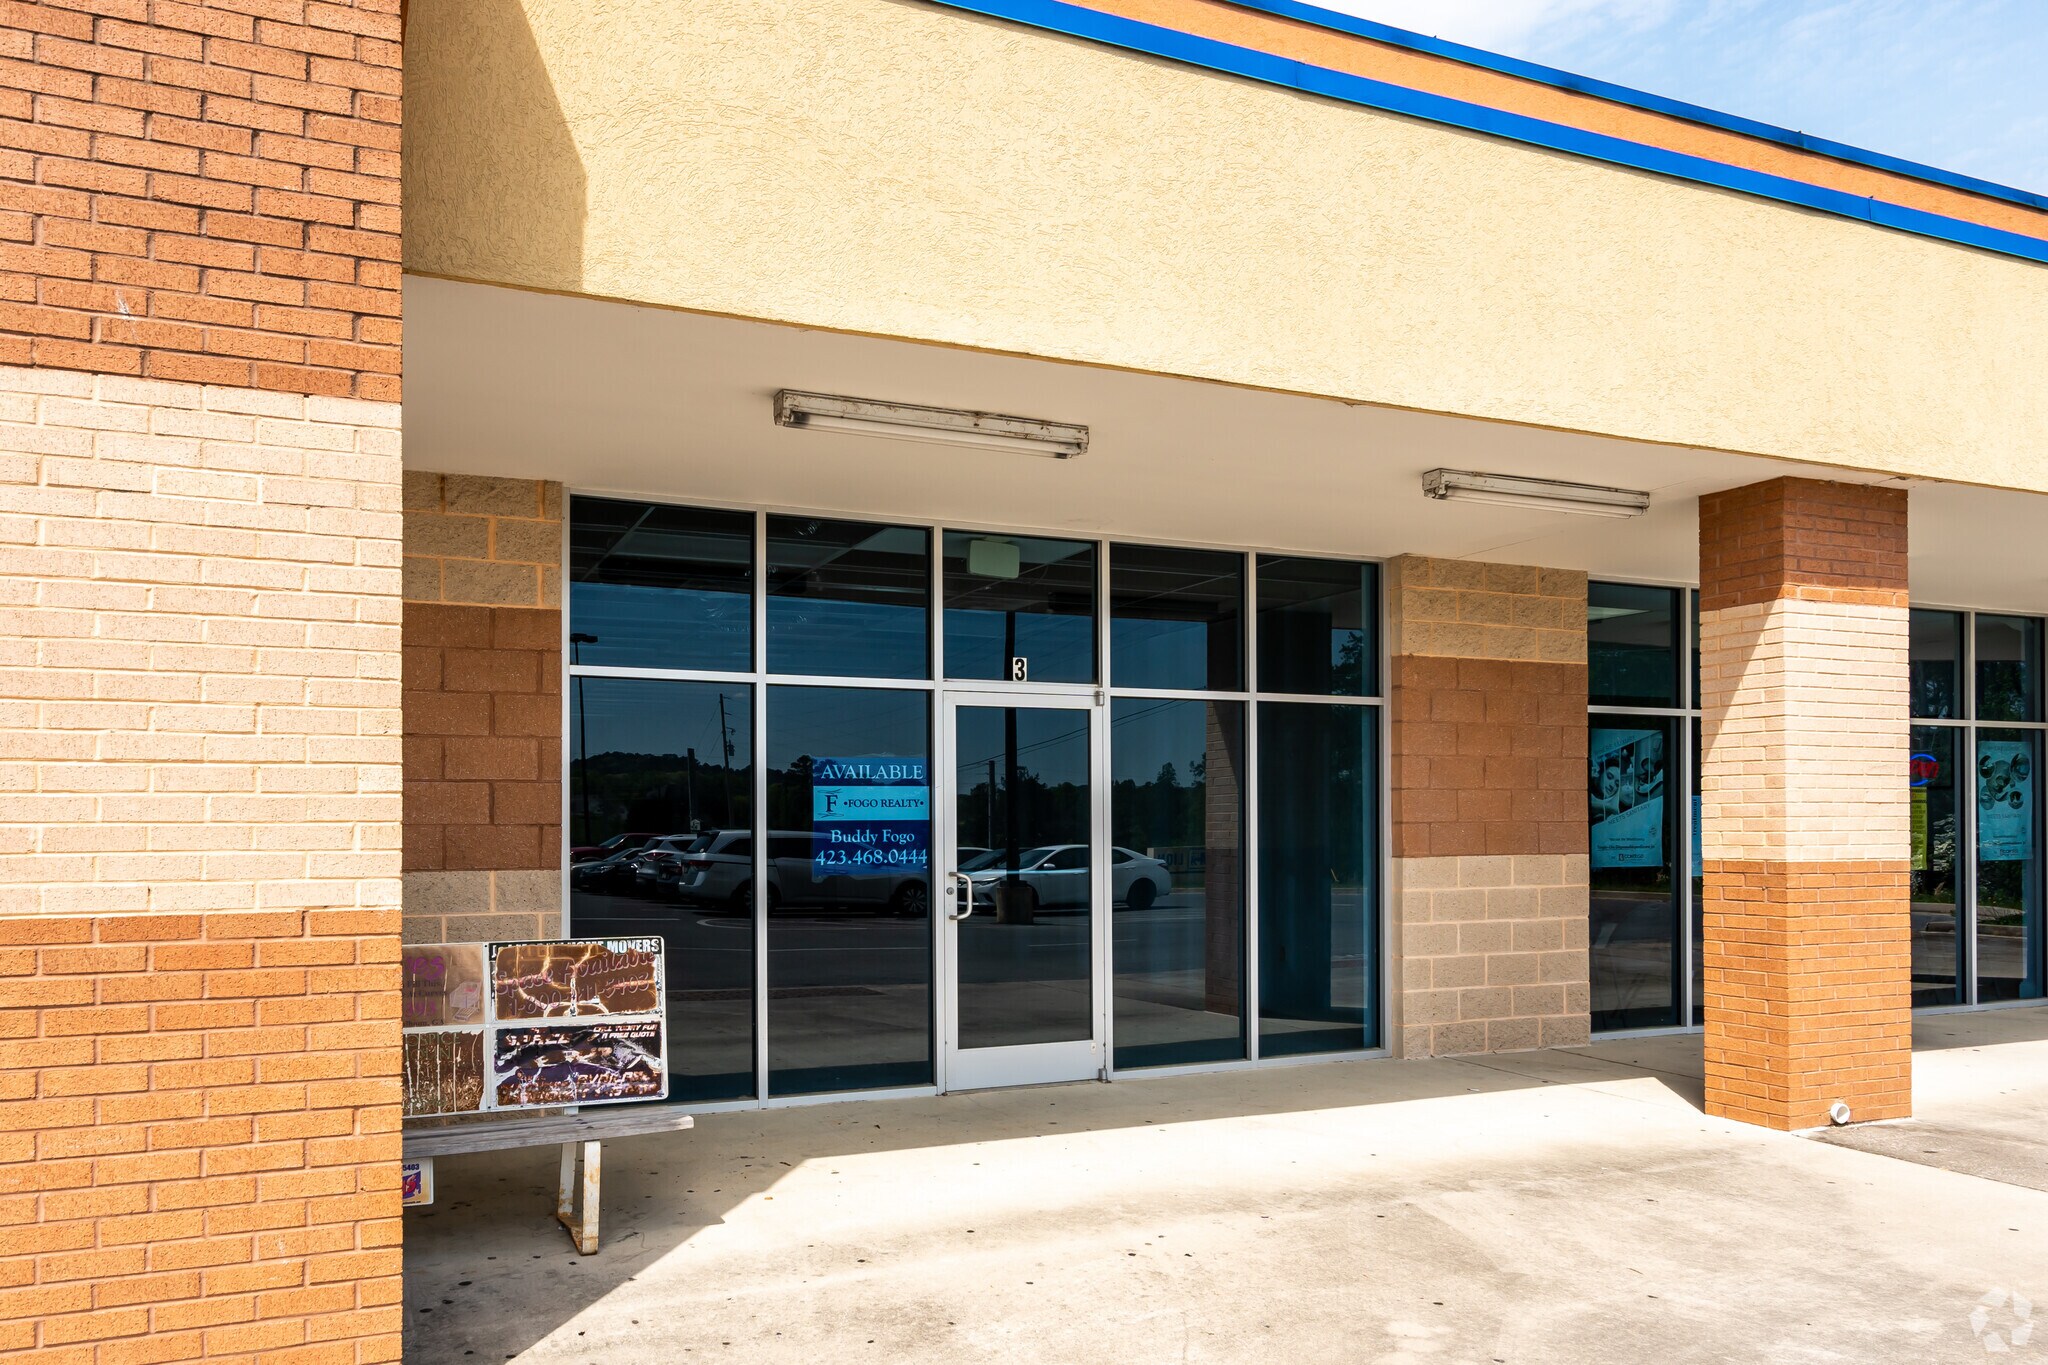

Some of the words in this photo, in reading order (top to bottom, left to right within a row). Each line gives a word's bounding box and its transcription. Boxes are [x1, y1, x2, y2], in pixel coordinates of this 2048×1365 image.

[1014, 658, 1025, 681] 3
[820, 764, 924, 779] AVAILABLE
[825, 794, 839, 812] F
[848, 799, 878, 808] FOGO
[881, 799, 921, 808] REALTY
[831, 829, 878, 844] Buddy
[883, 829, 915, 845] Fogo
[816, 849, 928, 866] 423.468.0444
[607, 938, 660, 953] MOVERS
